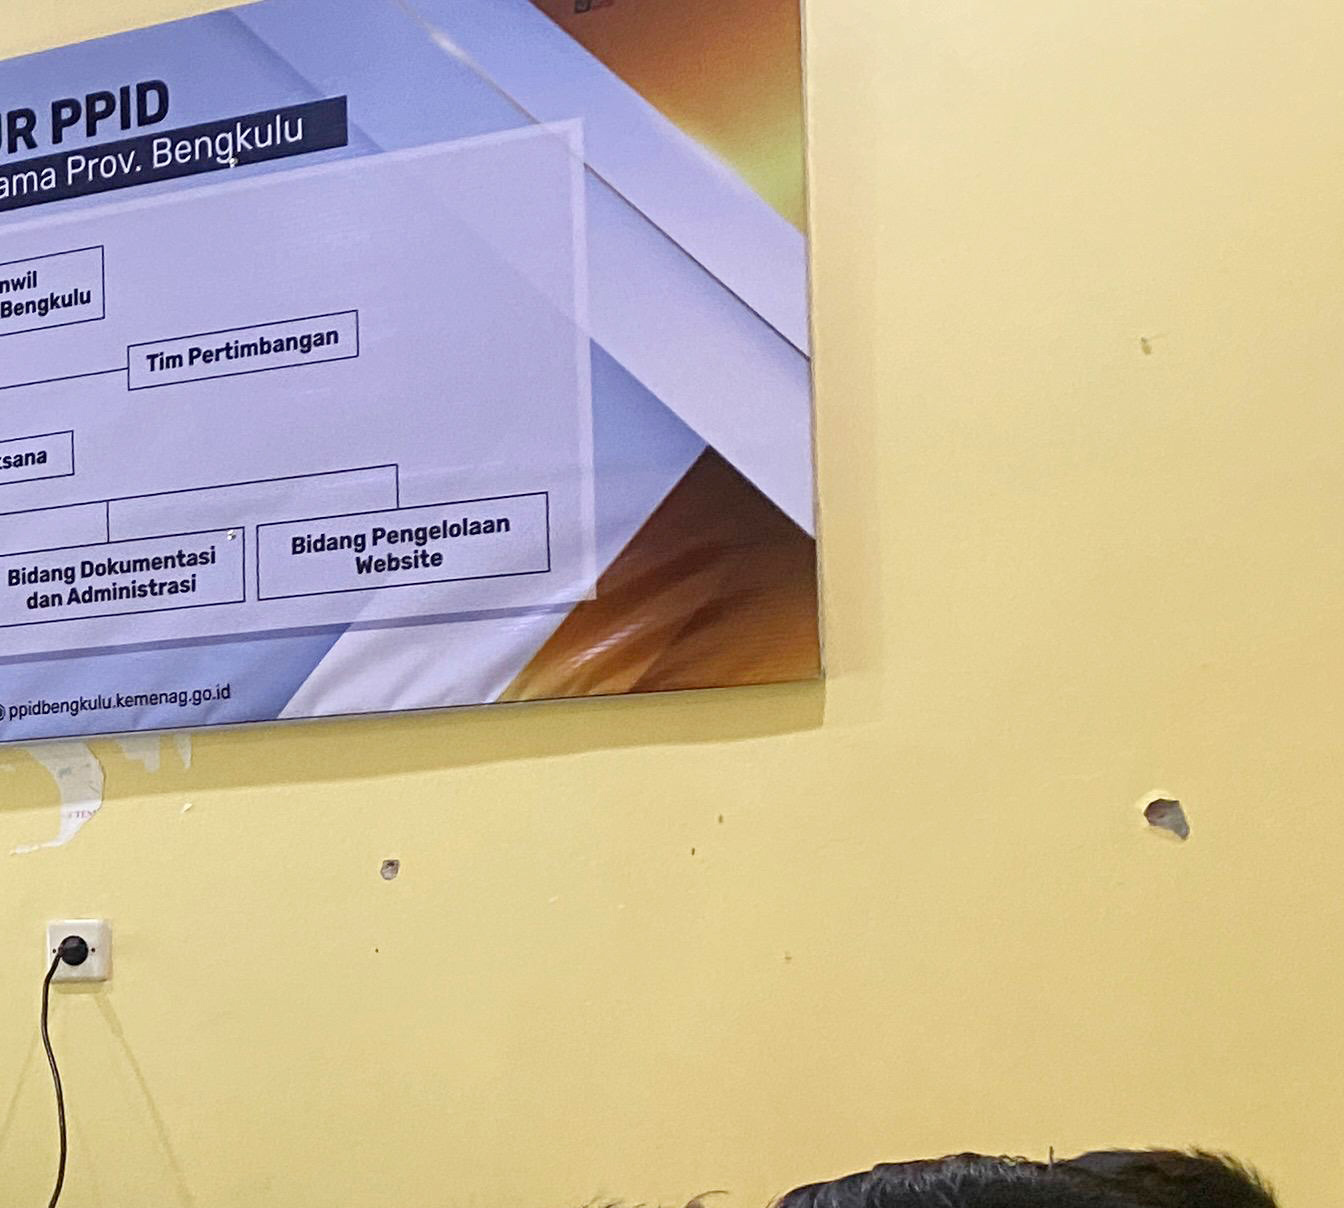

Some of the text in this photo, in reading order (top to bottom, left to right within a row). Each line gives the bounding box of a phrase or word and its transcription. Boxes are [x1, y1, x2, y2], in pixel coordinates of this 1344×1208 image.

[51, 78, 171, 146] PPID
[66, 148, 144, 187] Prov.
[152, 113, 305, 170] Bengkulu
[0, 284, 92, 325] Bengkulu
[146, 325, 340, 374] Tim Pertimbangan
[290, 512, 511, 562] Bidang Pengelolaan
[7, 544, 217, 592] Bidang Dokumentasi
[354, 546, 444, 577] Website
[25, 574, 197, 611] dan Administrasi
[7, 681, 232, 724] ppidbengkulu.kemenag.go.id
